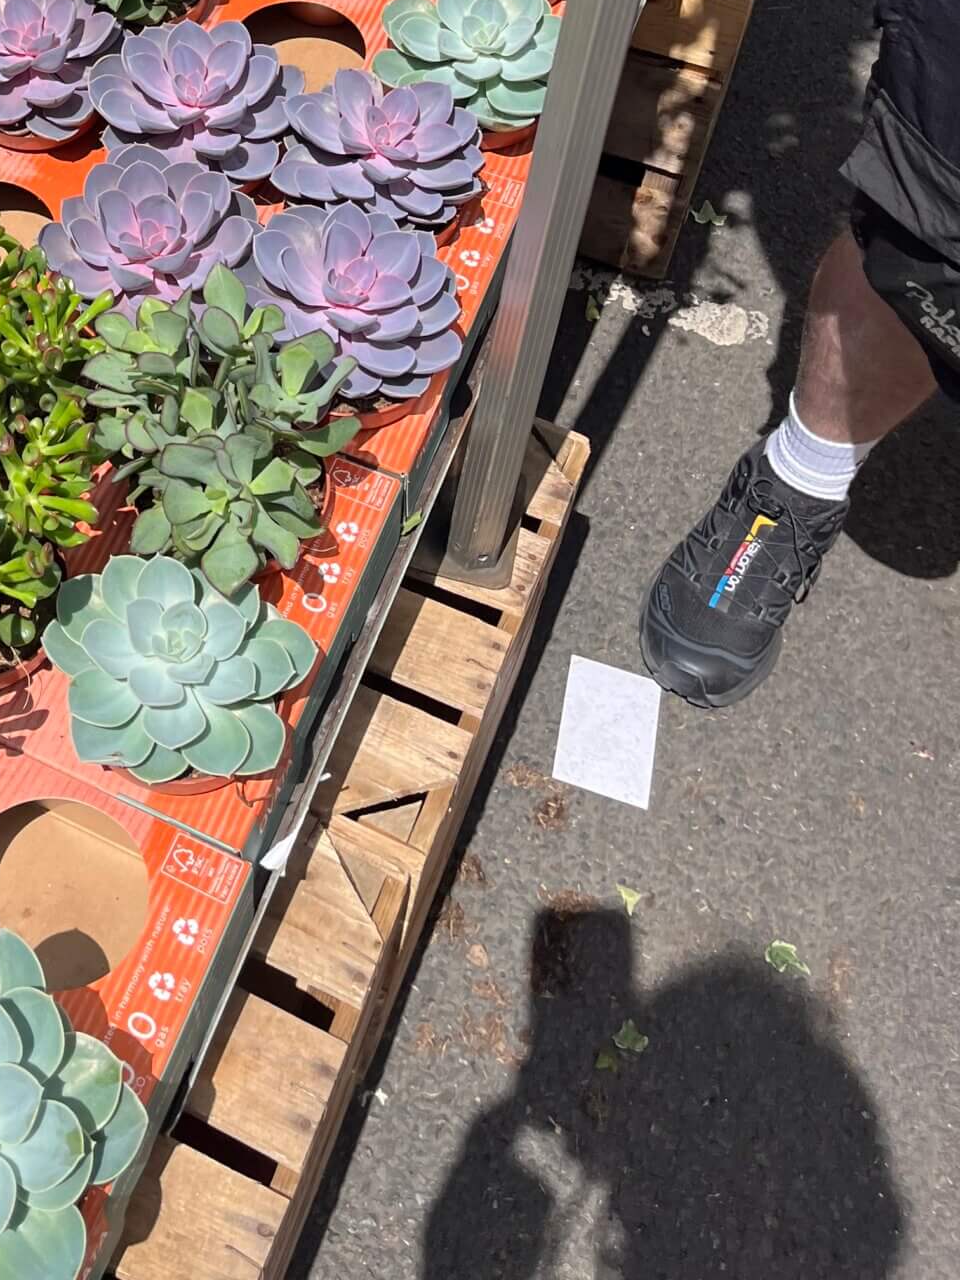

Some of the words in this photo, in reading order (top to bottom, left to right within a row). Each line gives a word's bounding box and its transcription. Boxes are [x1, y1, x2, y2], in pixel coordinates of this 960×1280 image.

[197, 927, 213, 955] pots
[119, 963, 145, 1009] harmony
[142, 939, 155, 962] with
[175, 977, 192, 1003] tray
[155, 1026, 170, 1049] gas
